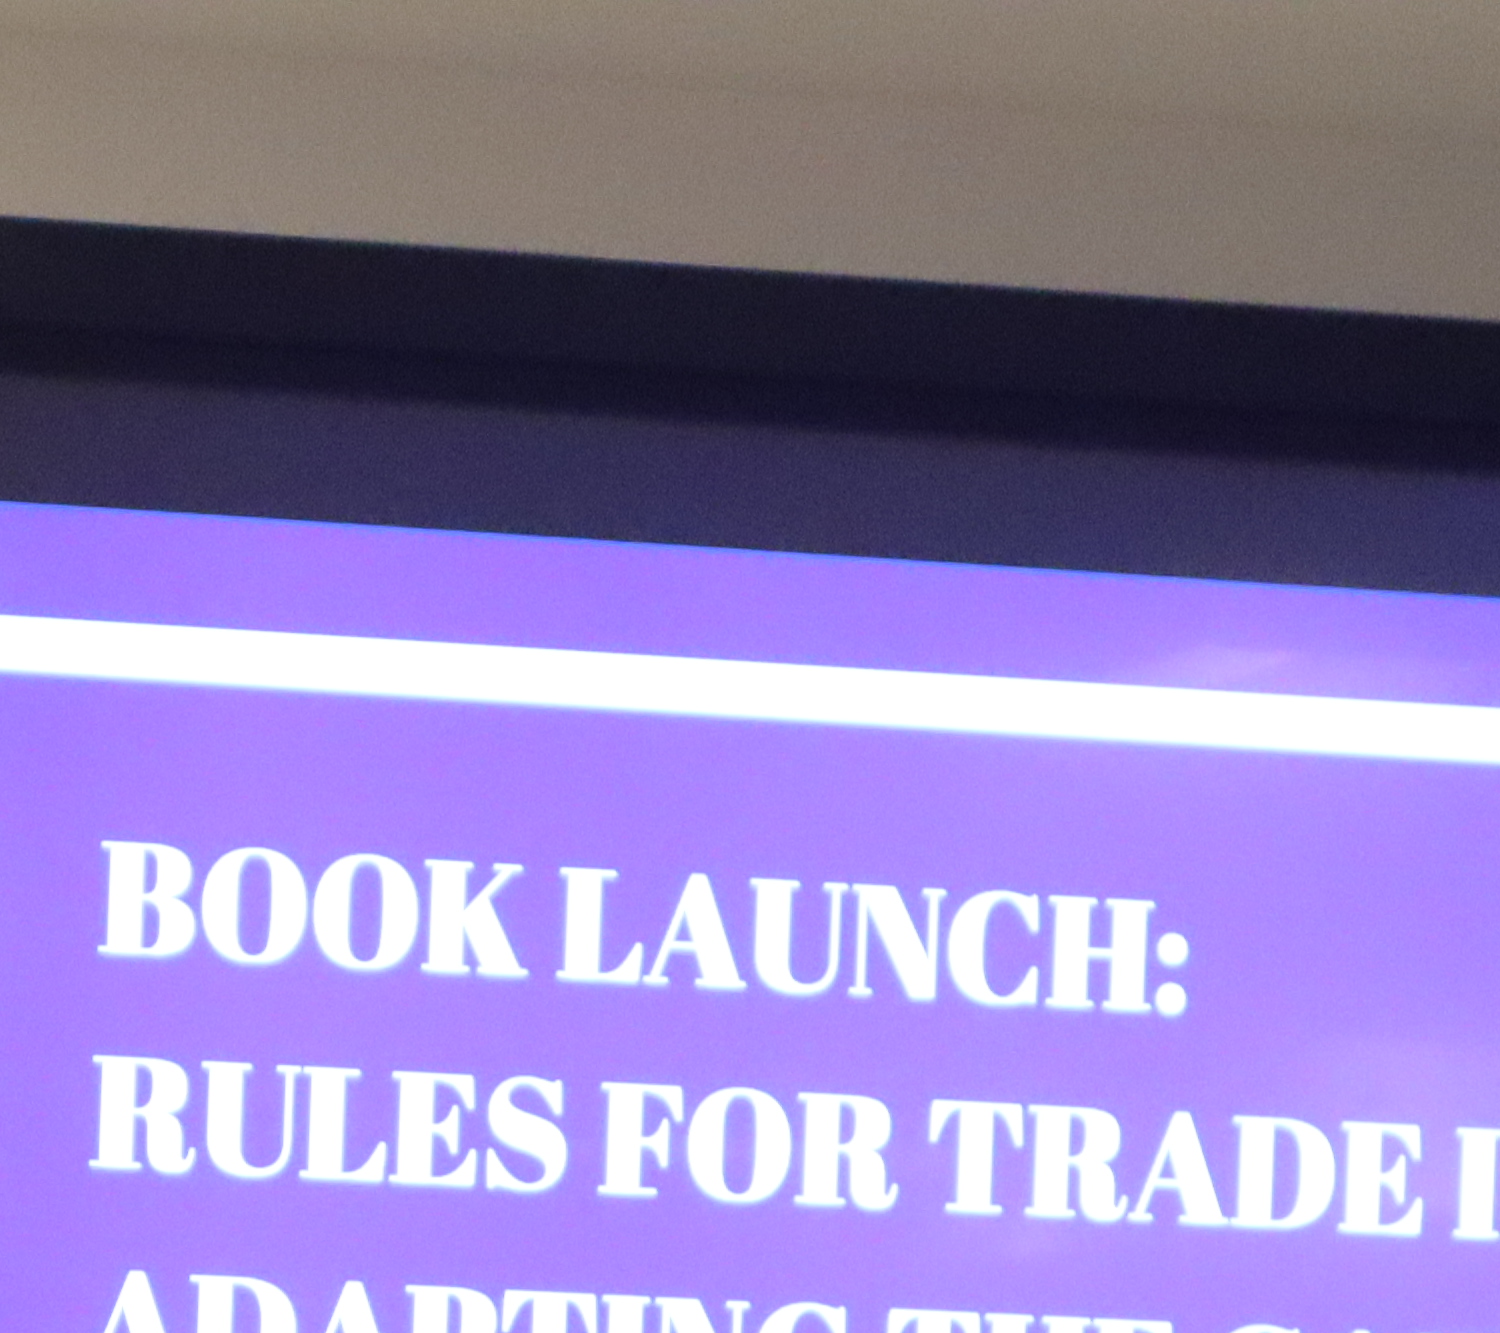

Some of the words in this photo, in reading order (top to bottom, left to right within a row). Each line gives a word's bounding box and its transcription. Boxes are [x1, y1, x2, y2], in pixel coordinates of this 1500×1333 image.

[98, 841, 529, 979] BOOK
[556, 867, 1189, 1017] LAUNCH:
[89, 1055, 568, 1193] RULES
[597, 1082, 899, 1212] FOR
[928, 1099, 1424, 1238] TRADE
